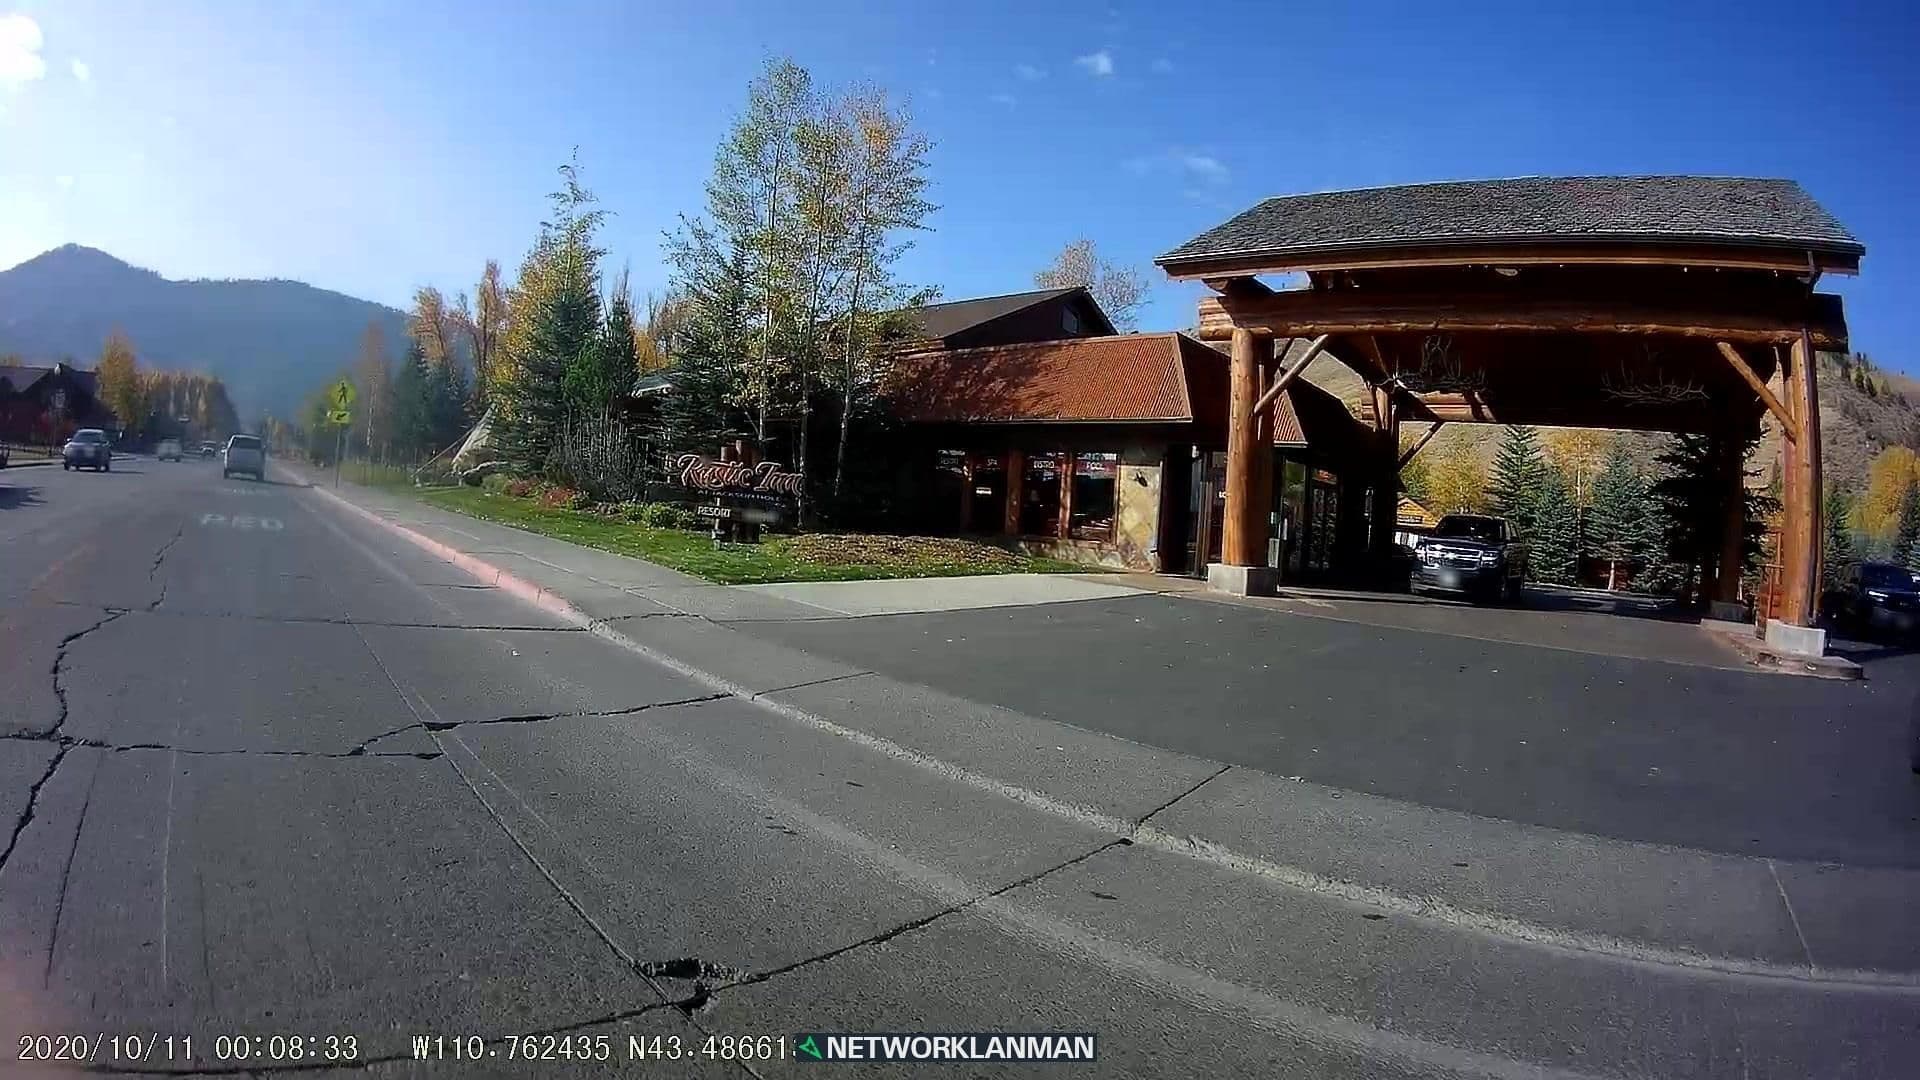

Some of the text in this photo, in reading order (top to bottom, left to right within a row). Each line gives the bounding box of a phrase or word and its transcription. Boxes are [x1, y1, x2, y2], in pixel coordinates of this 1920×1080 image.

[677, 454, 803, 497] Rustic Inn
[201, 512, 284, 530] PED
[697, 506, 731, 518] RESORT
